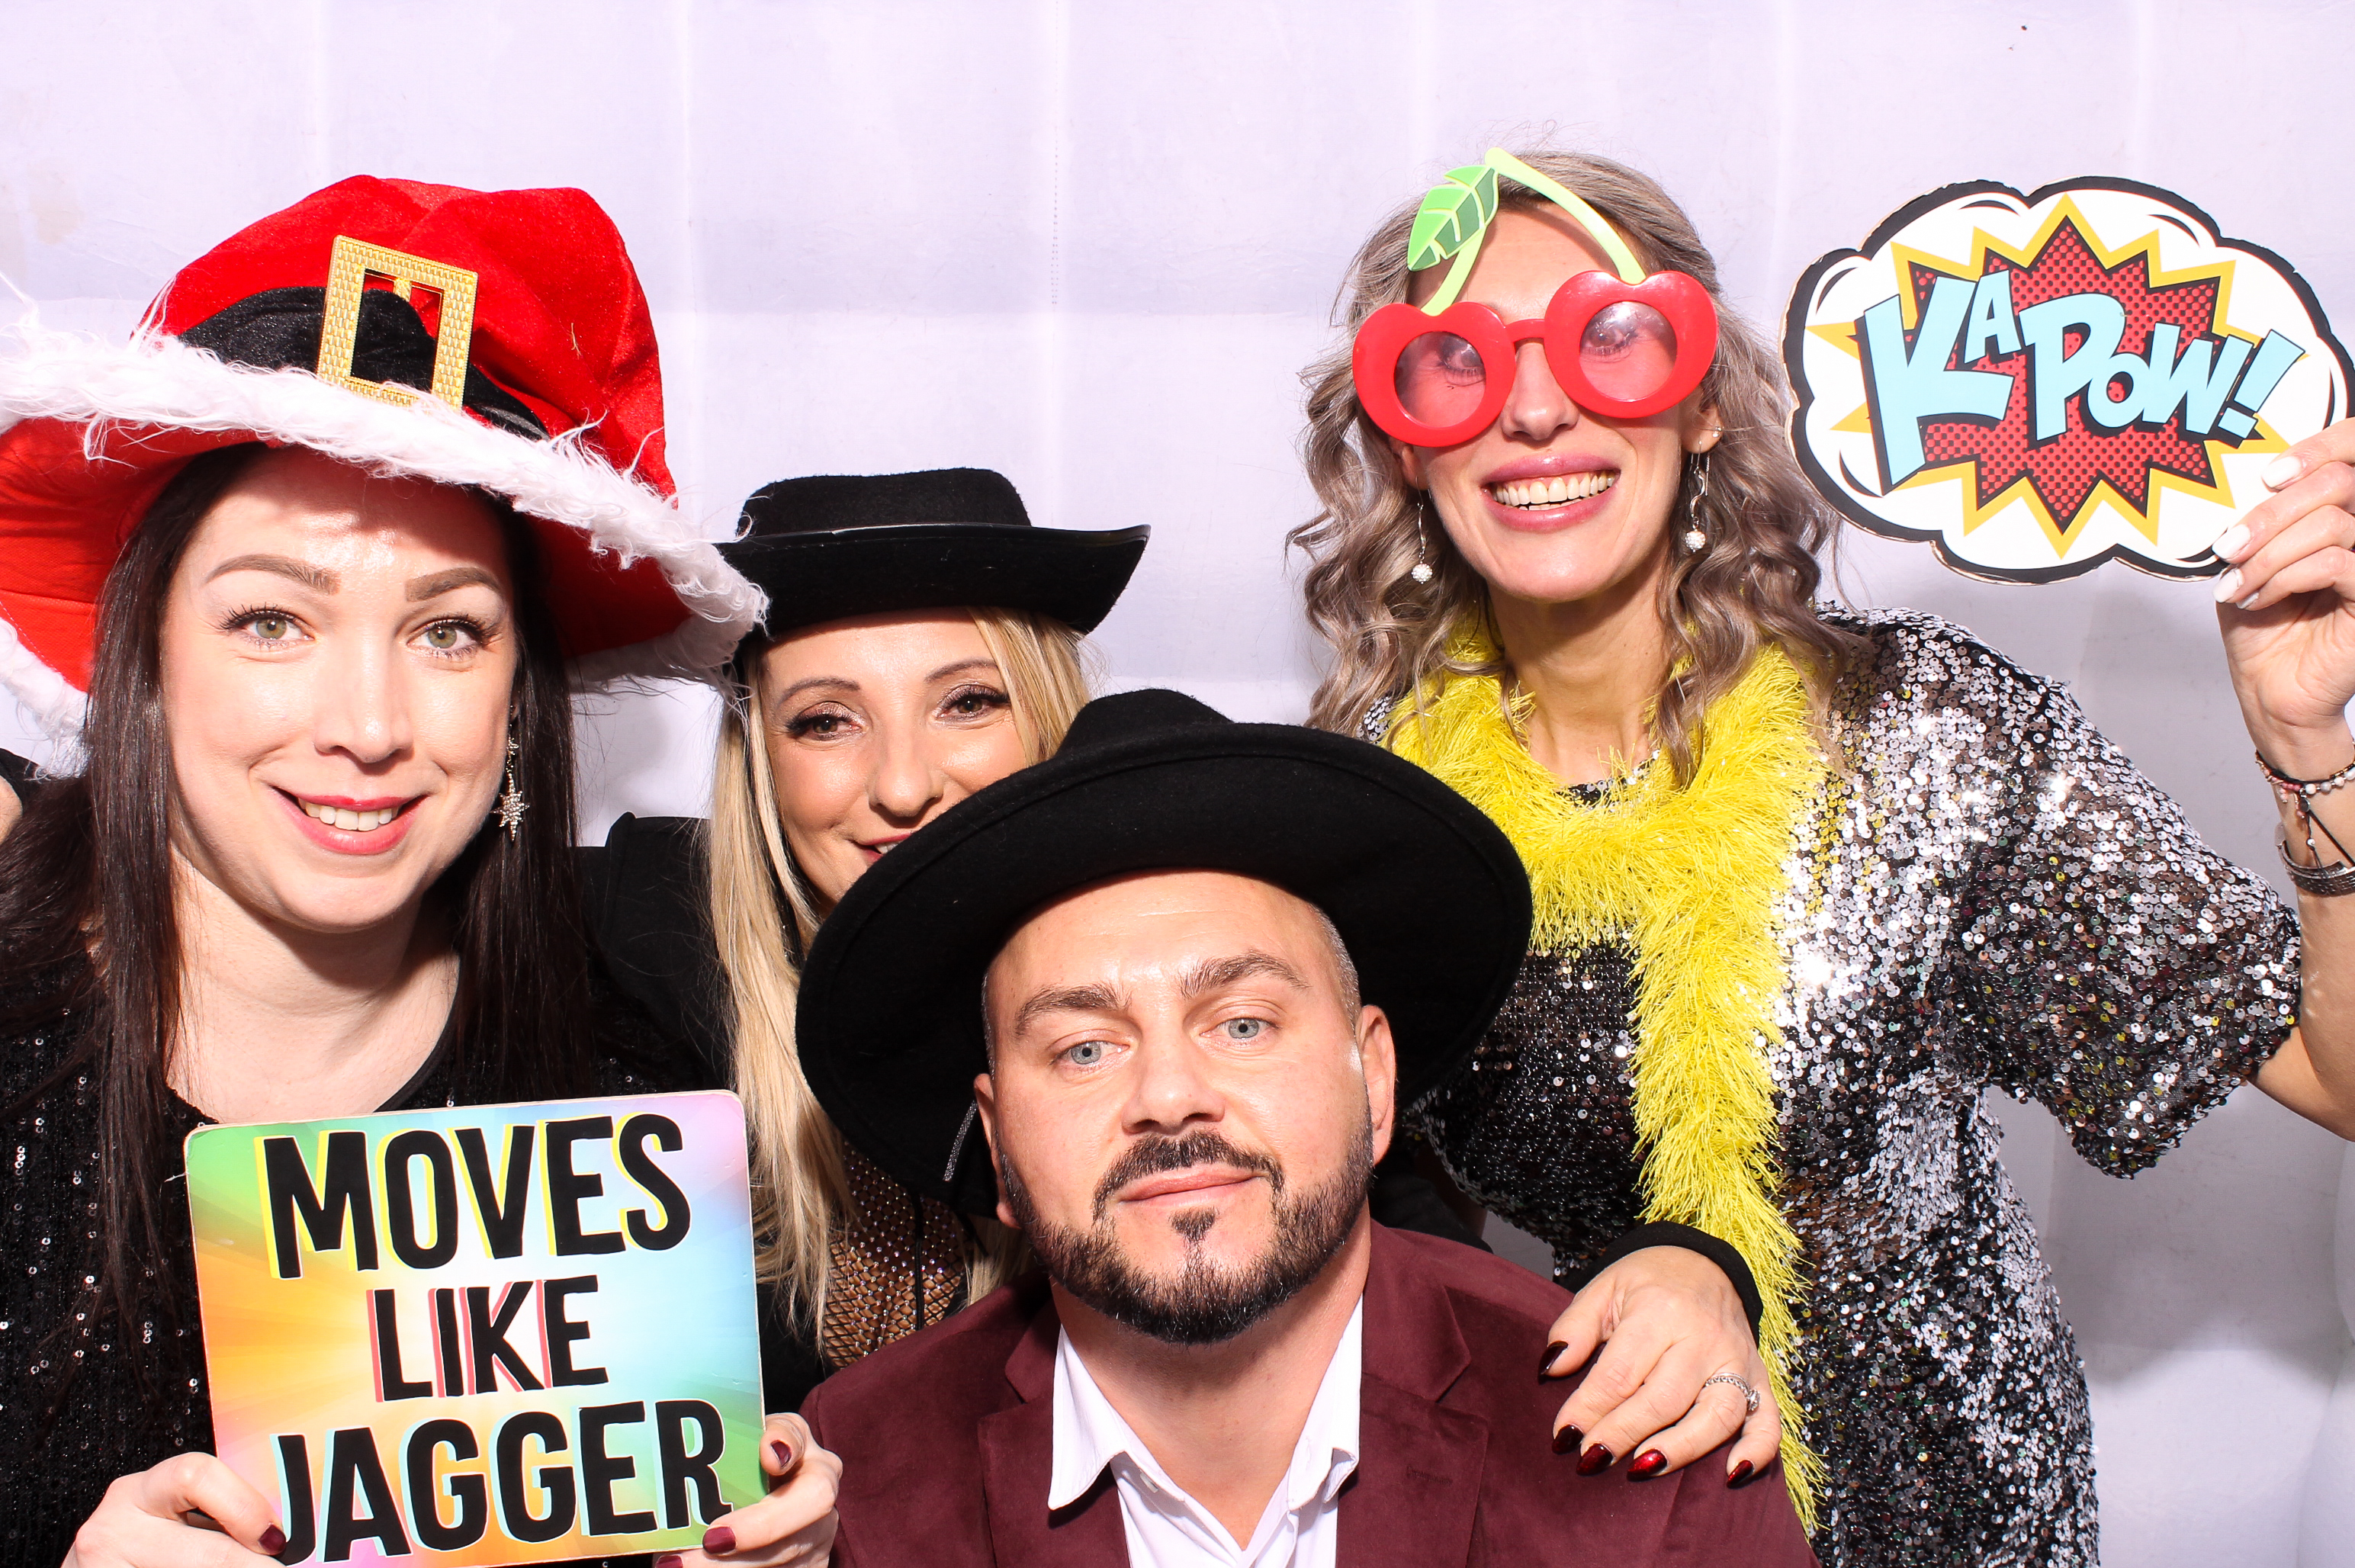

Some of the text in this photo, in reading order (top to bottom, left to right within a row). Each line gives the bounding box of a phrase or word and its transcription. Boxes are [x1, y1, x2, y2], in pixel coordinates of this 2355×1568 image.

[256, 1113, 691, 1278] MOVES
[367, 1275, 609, 1403] LIKE
[268, 1399, 733, 1566] JAGGER
